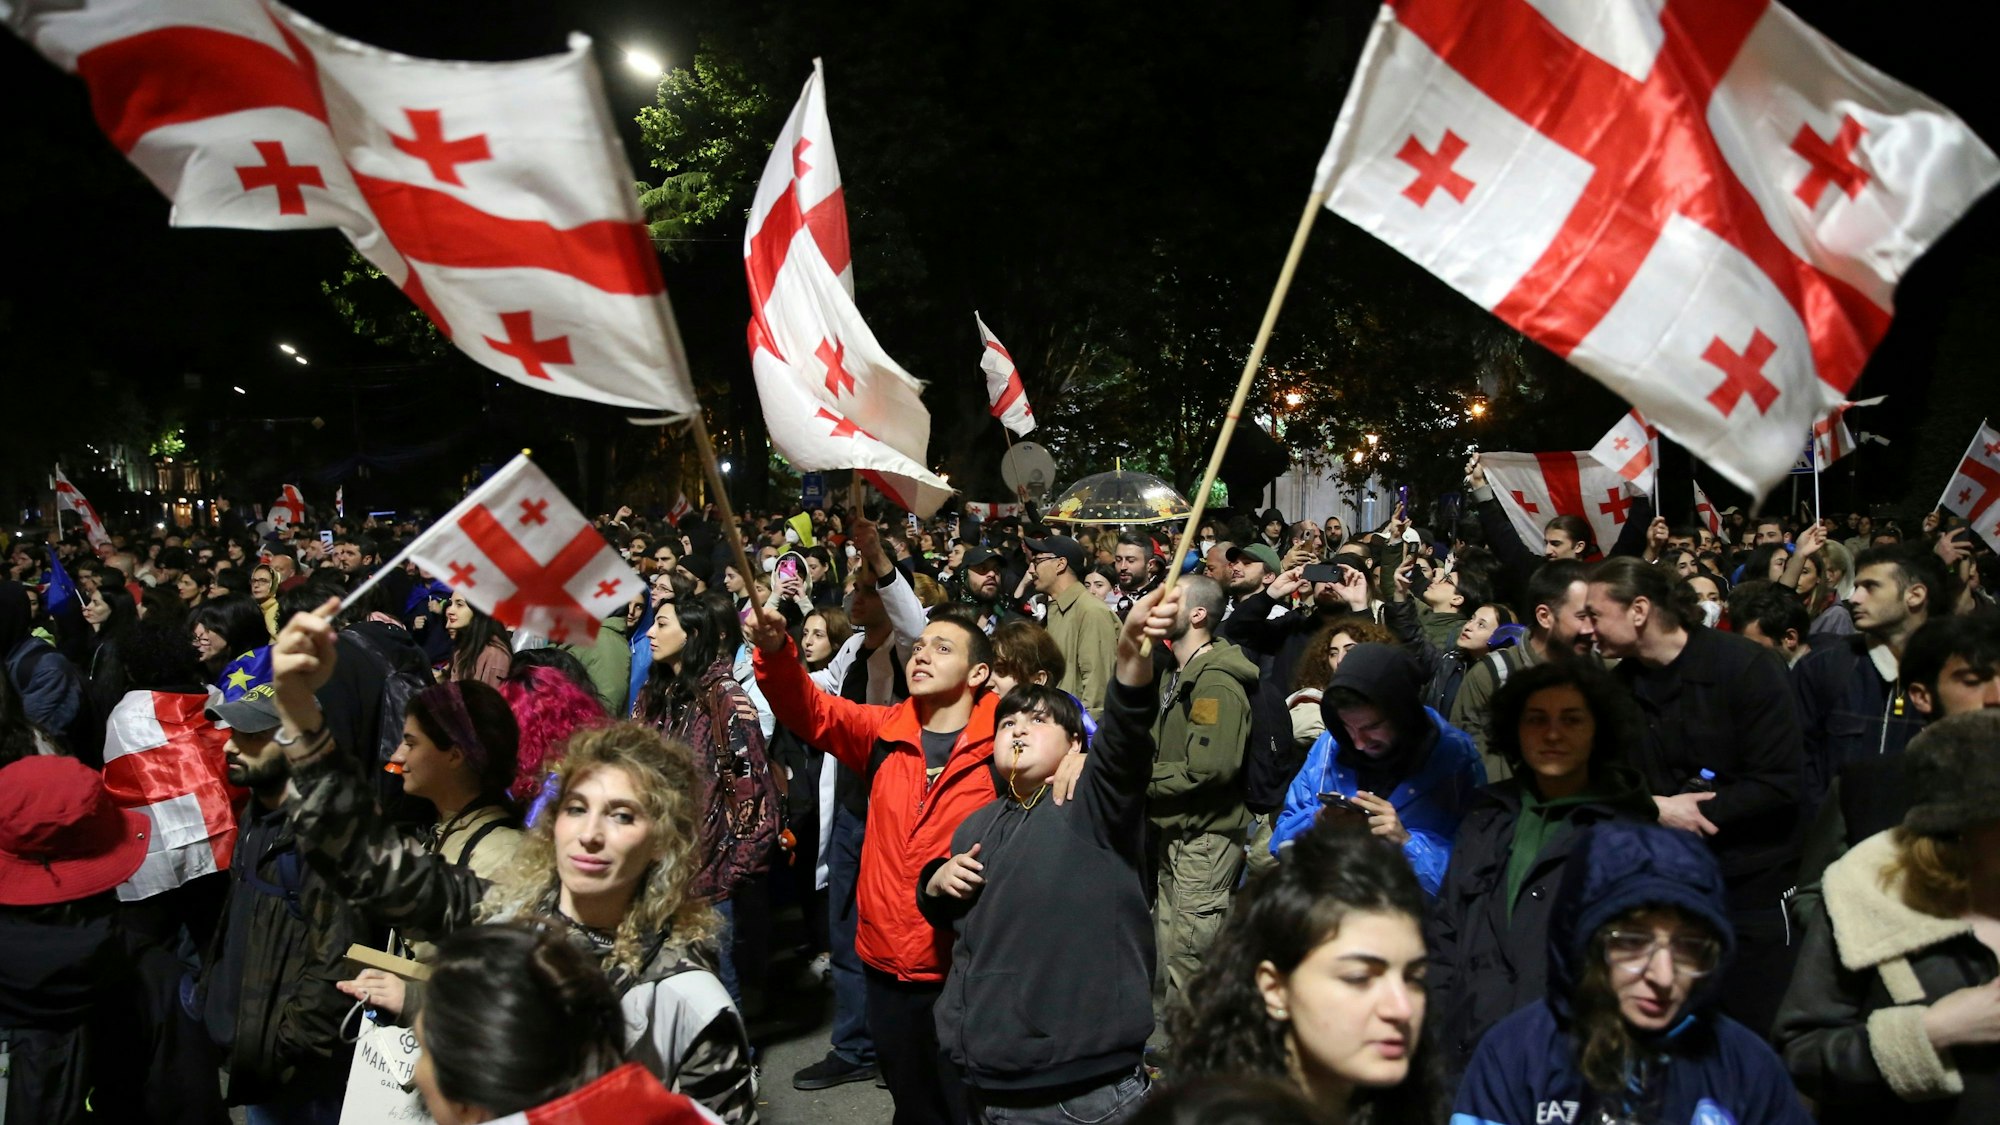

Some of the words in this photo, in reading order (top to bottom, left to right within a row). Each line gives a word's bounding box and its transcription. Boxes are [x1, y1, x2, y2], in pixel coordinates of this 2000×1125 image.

[361, 1041, 415, 1079] MARTH
[380, 1079, 403, 1091] GALE
[1536, 1100, 1580, 1124] EA7
